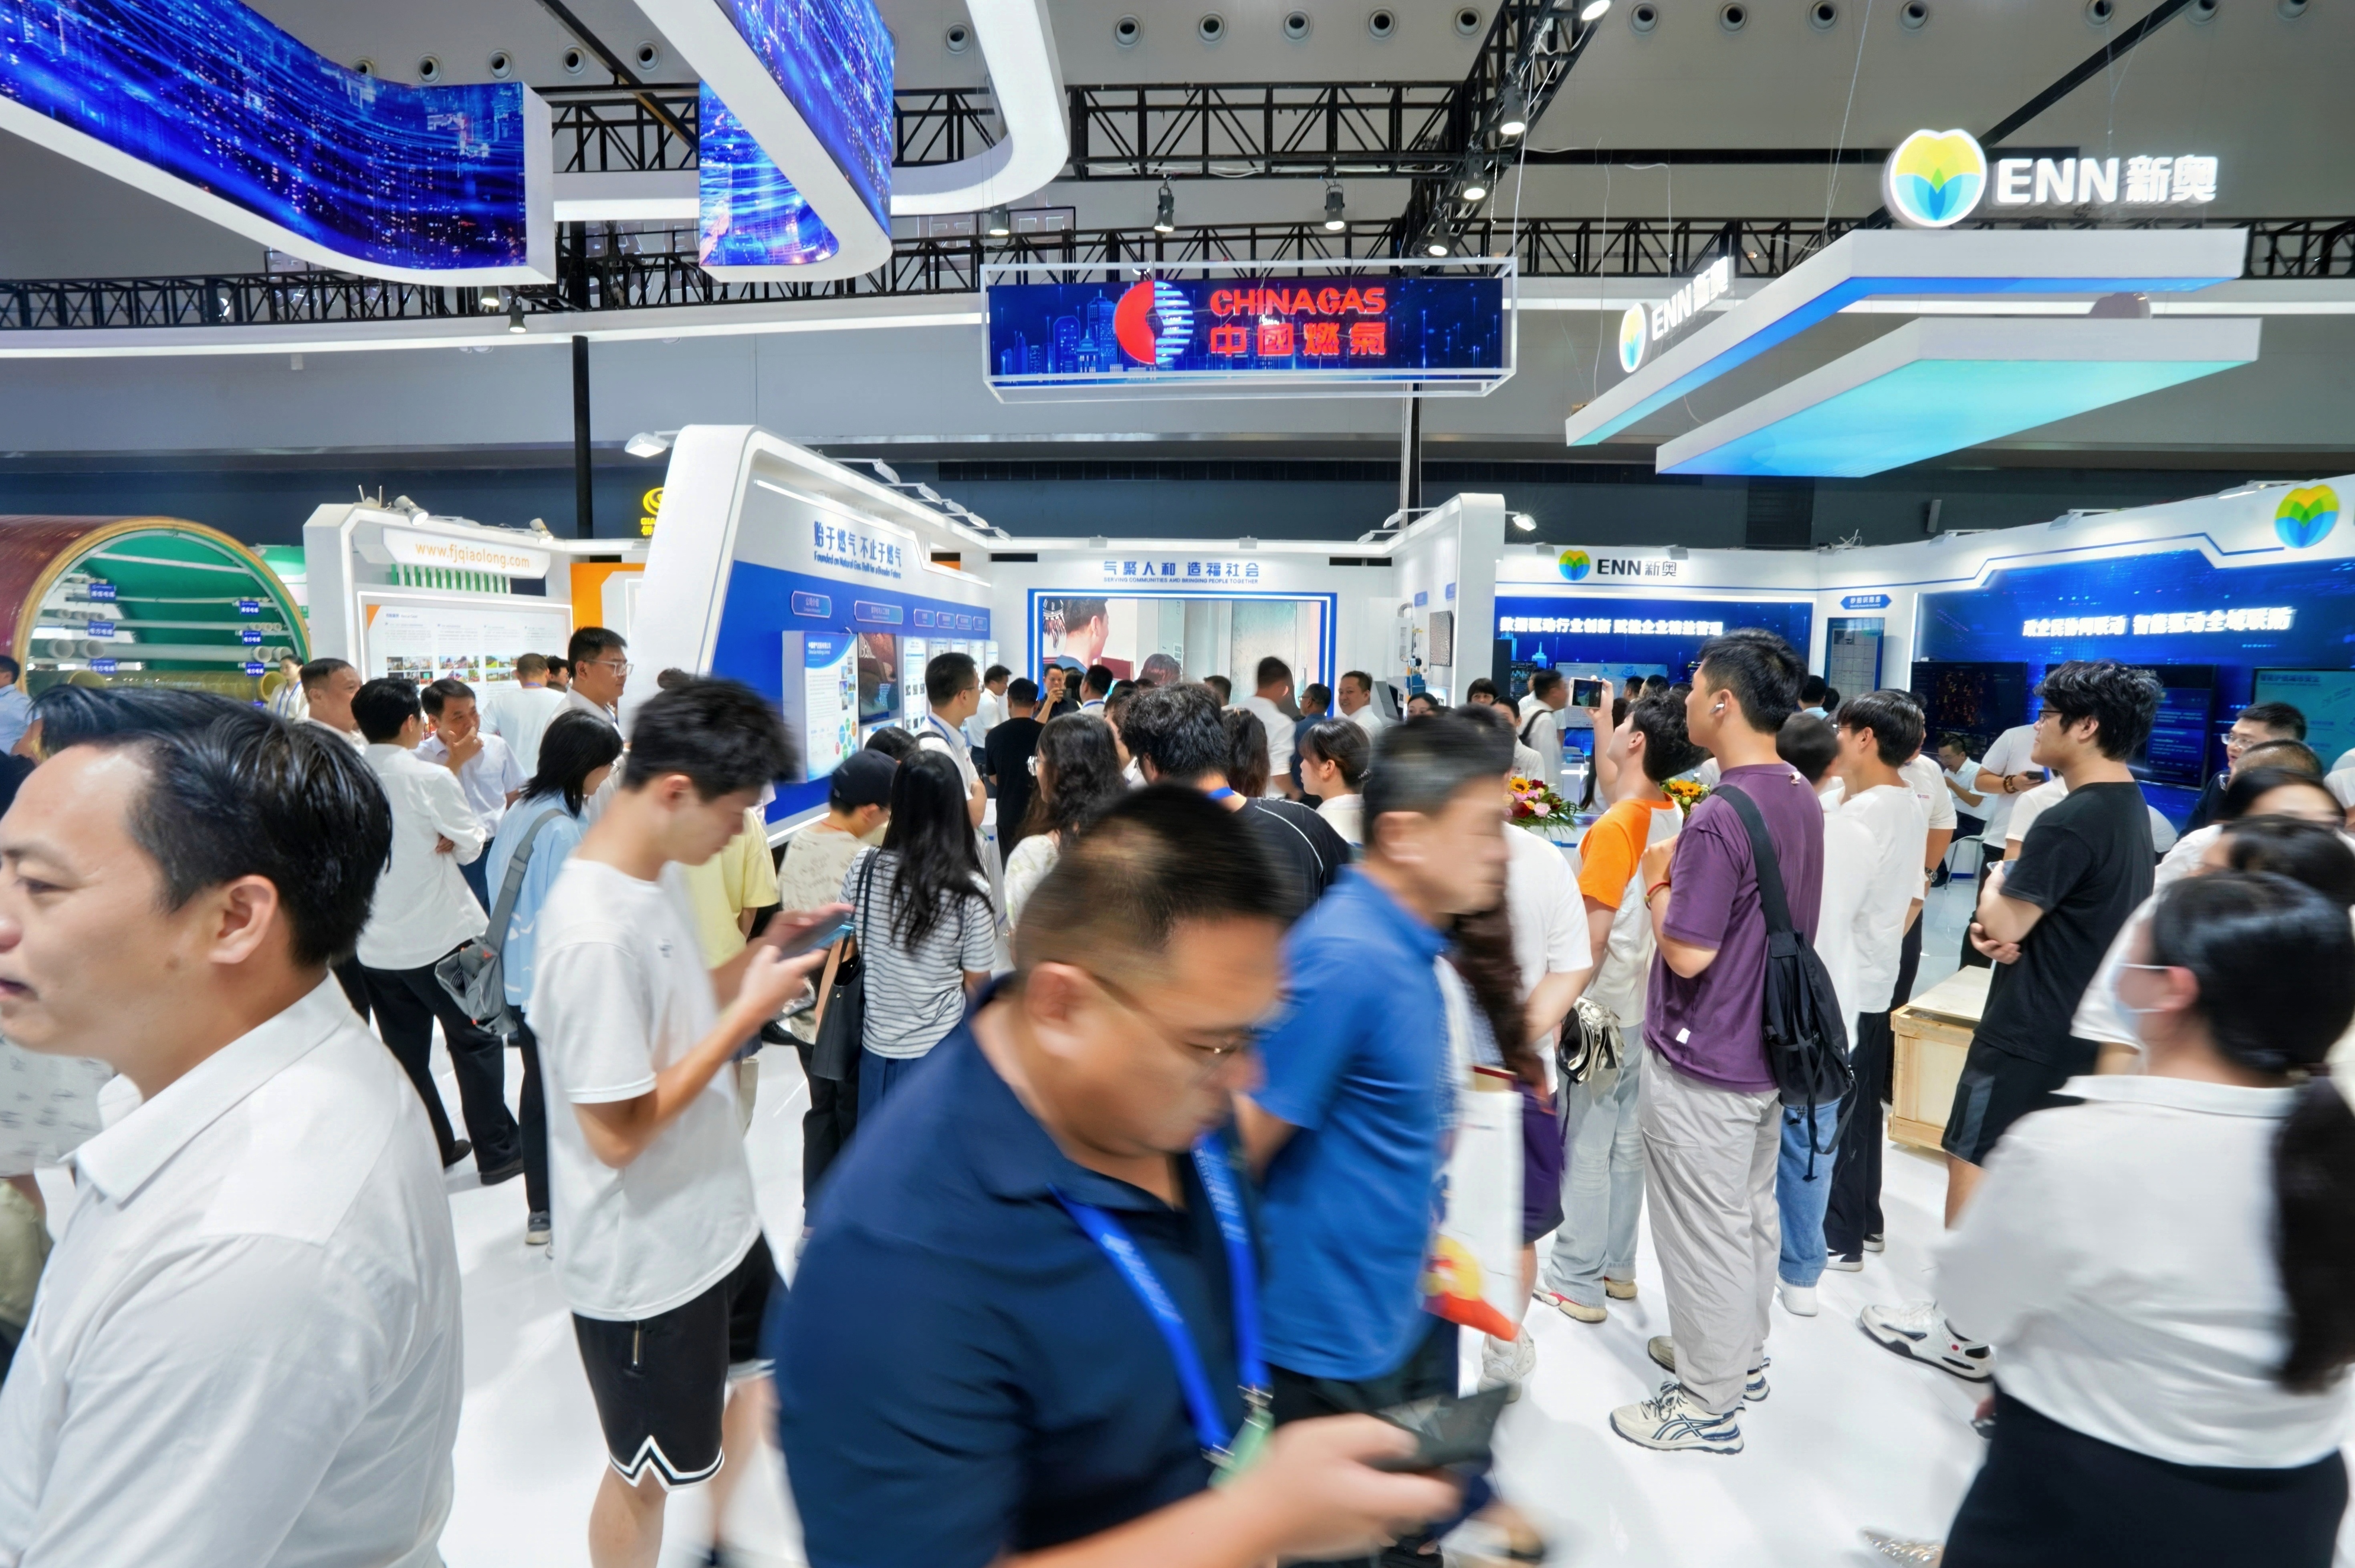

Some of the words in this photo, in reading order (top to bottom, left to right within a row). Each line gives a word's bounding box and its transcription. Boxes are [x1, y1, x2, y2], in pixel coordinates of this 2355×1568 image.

[1997, 158, 2120, 203] ENN
[2126, 154, 2218, 202] 新奥
[1652, 283, 1691, 341] ENN
[416, 544, 529, 568] www.fjqiaolong.com
[1597, 559, 1641, 575] ENN
[1645, 561, 1677, 576] 新奥
[1104, 561, 1176, 576] 气聚人和
[1188, 562, 1259, 577] 造福社会
